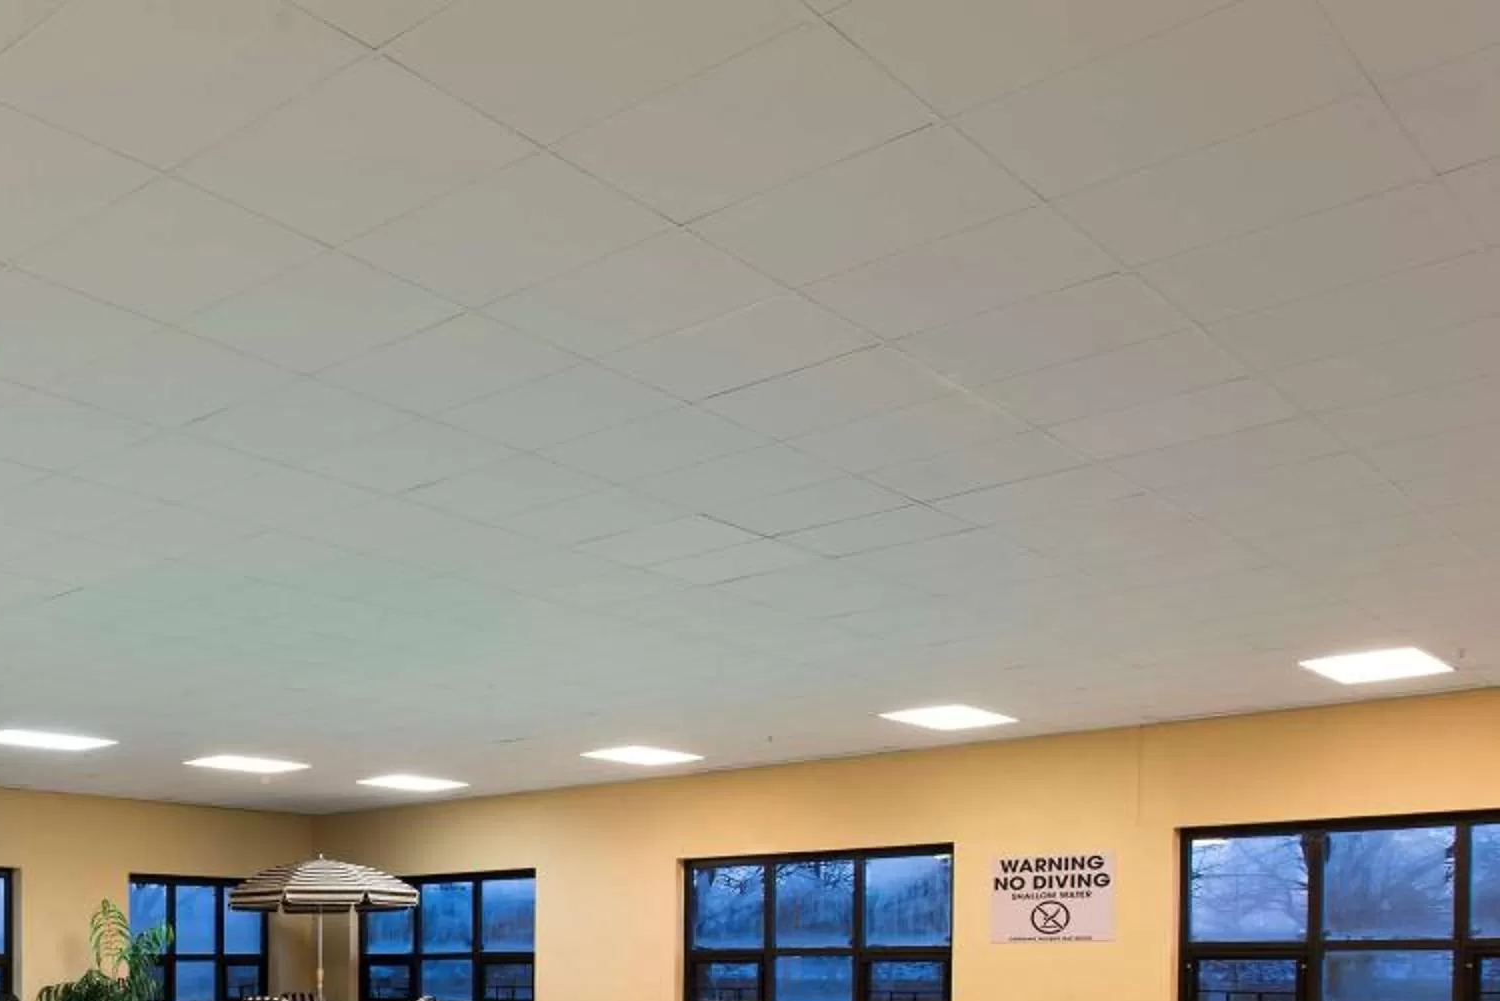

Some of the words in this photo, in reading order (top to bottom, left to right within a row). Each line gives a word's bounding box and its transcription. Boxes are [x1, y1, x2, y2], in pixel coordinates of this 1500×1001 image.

[999, 855, 1104, 874] WARNING
[993, 876, 1025, 891] NO
[1033, 872, 1111, 890] DIVING
[1011, 891, 1057, 901] SHALLOW
[1059, 890, 1093, 899] WATER
